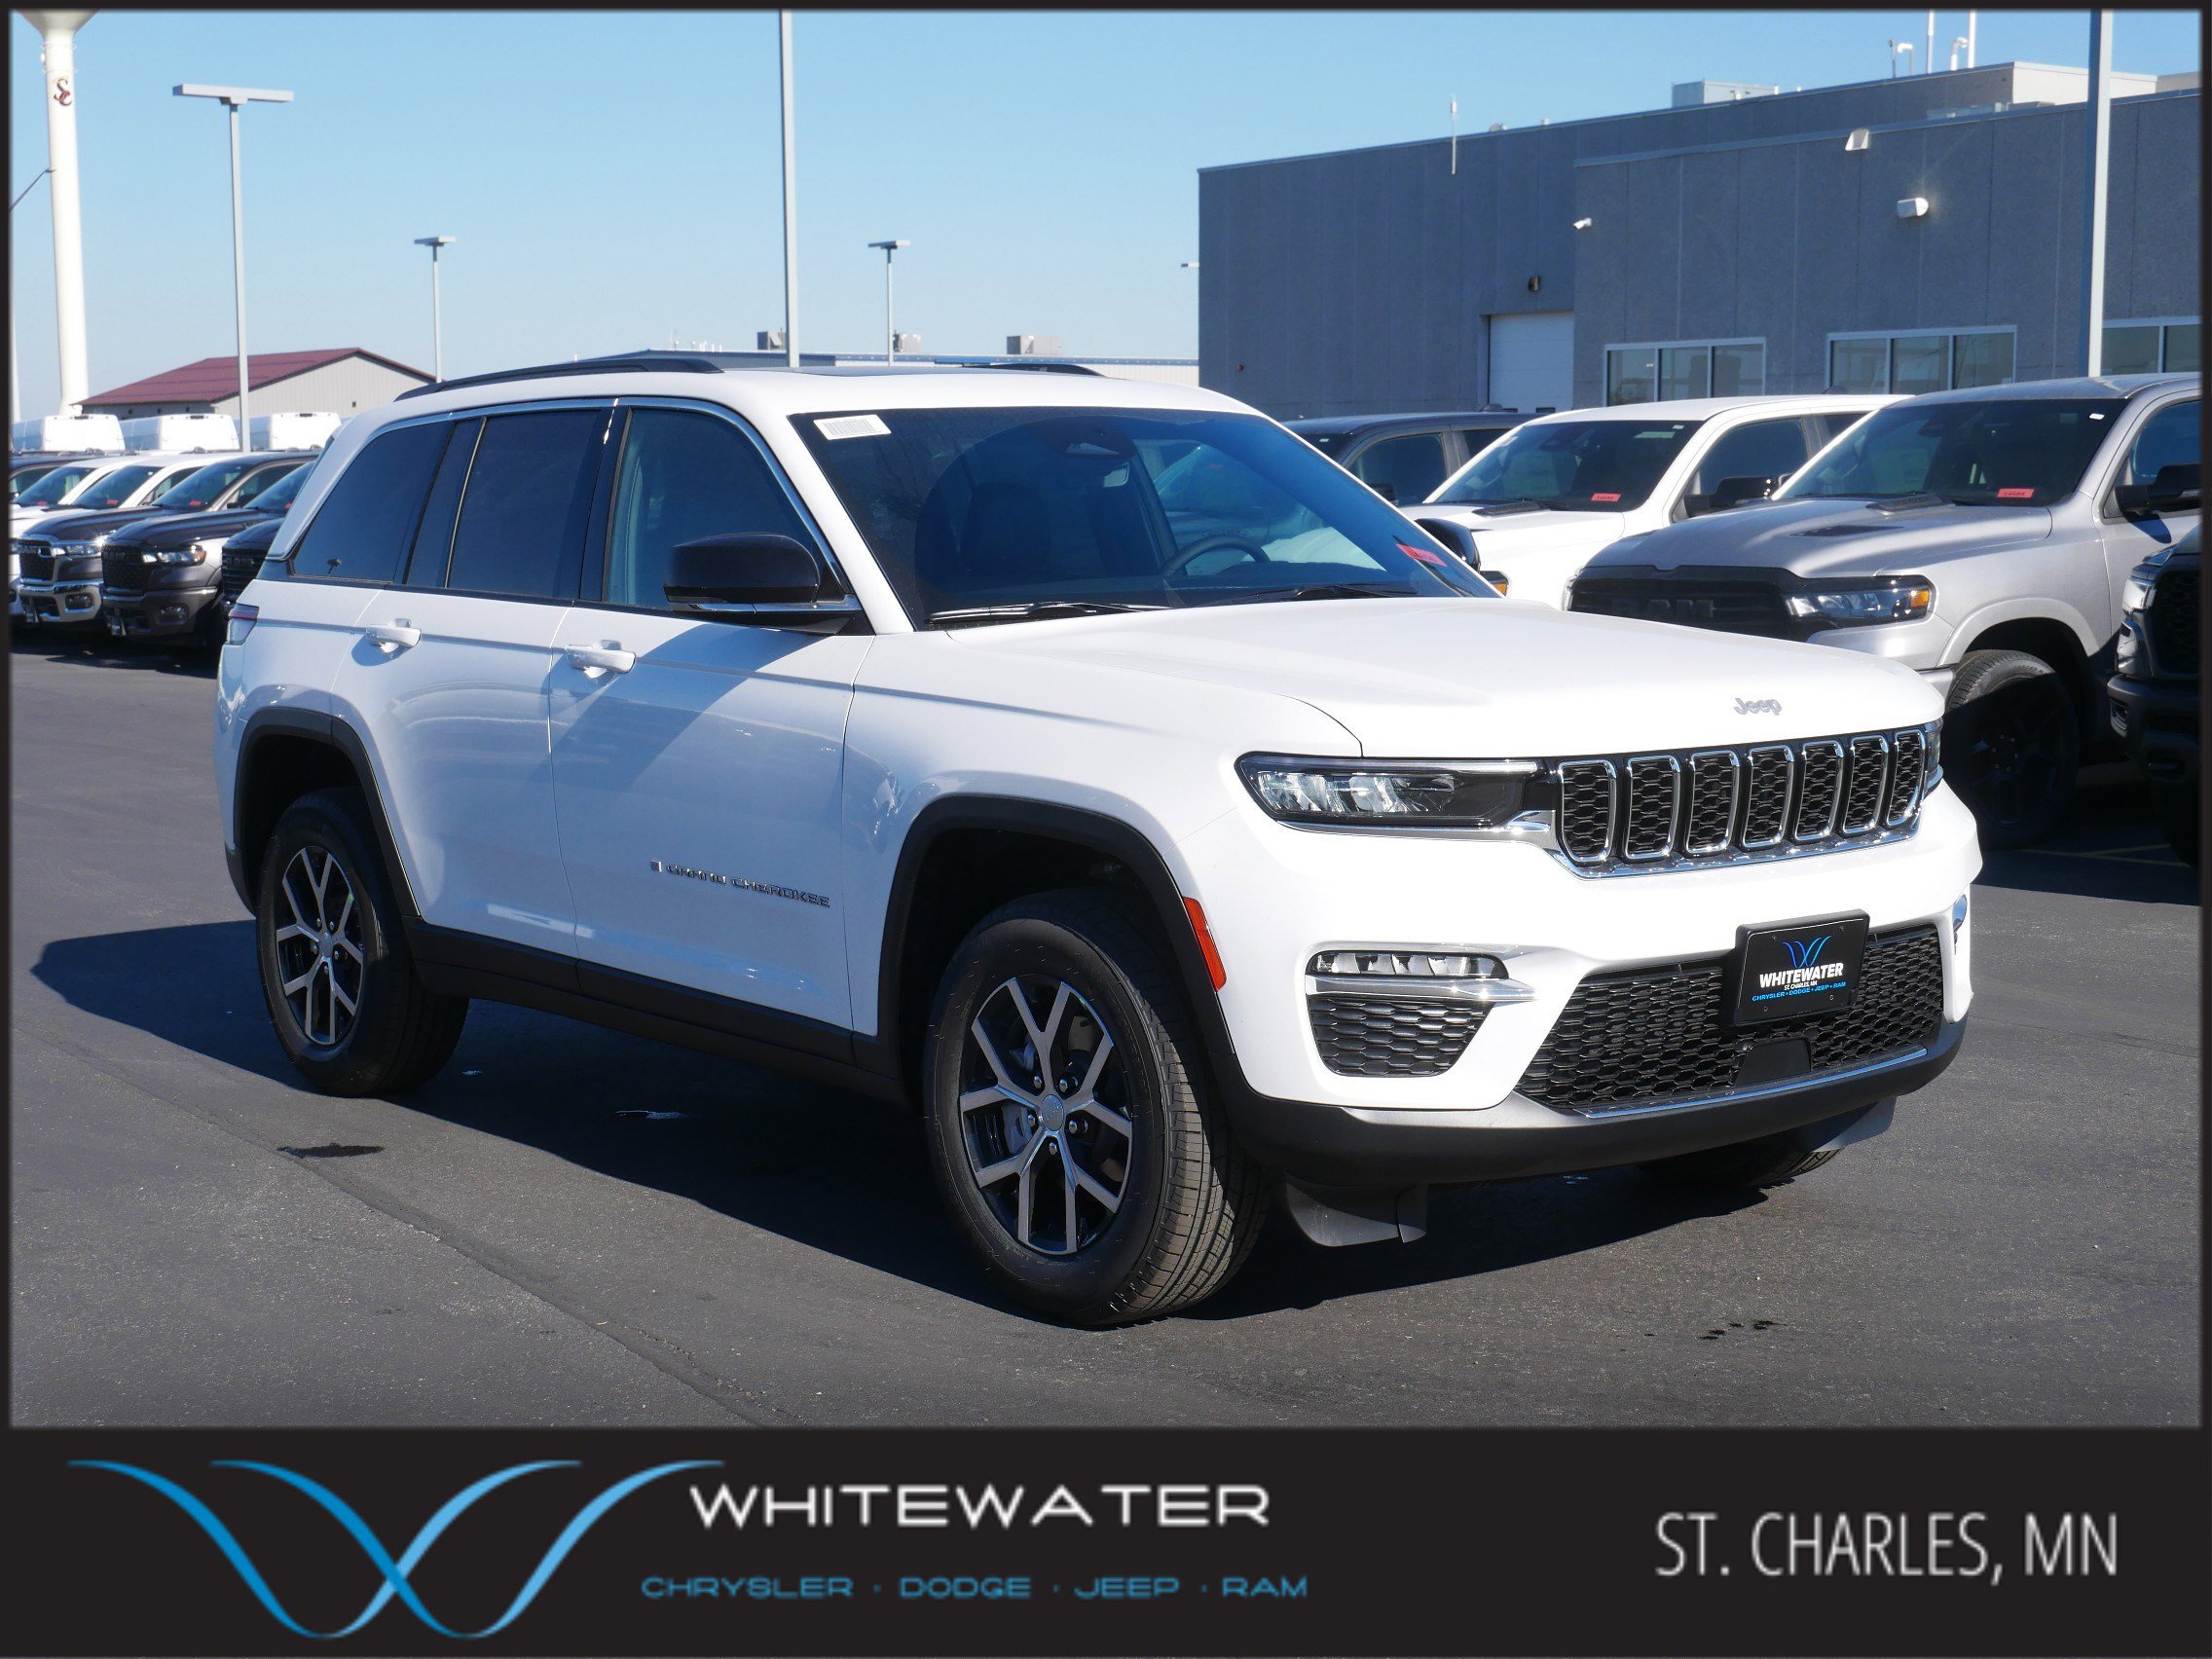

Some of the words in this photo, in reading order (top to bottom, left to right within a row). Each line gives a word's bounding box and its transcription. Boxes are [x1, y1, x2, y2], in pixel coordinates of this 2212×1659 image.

[1734, 697, 1783, 716] Jeep
[666, 864, 726, 885] GRAND
[732, 877, 830, 907] CHEROKEE
[1759, 962, 1844, 988] WHITEWATER
[1751, 991, 1786, 1002] CHRYSLER
[1788, 987, 1811, 996] DODGE
[1832, 980, 1847, 989] RAM
